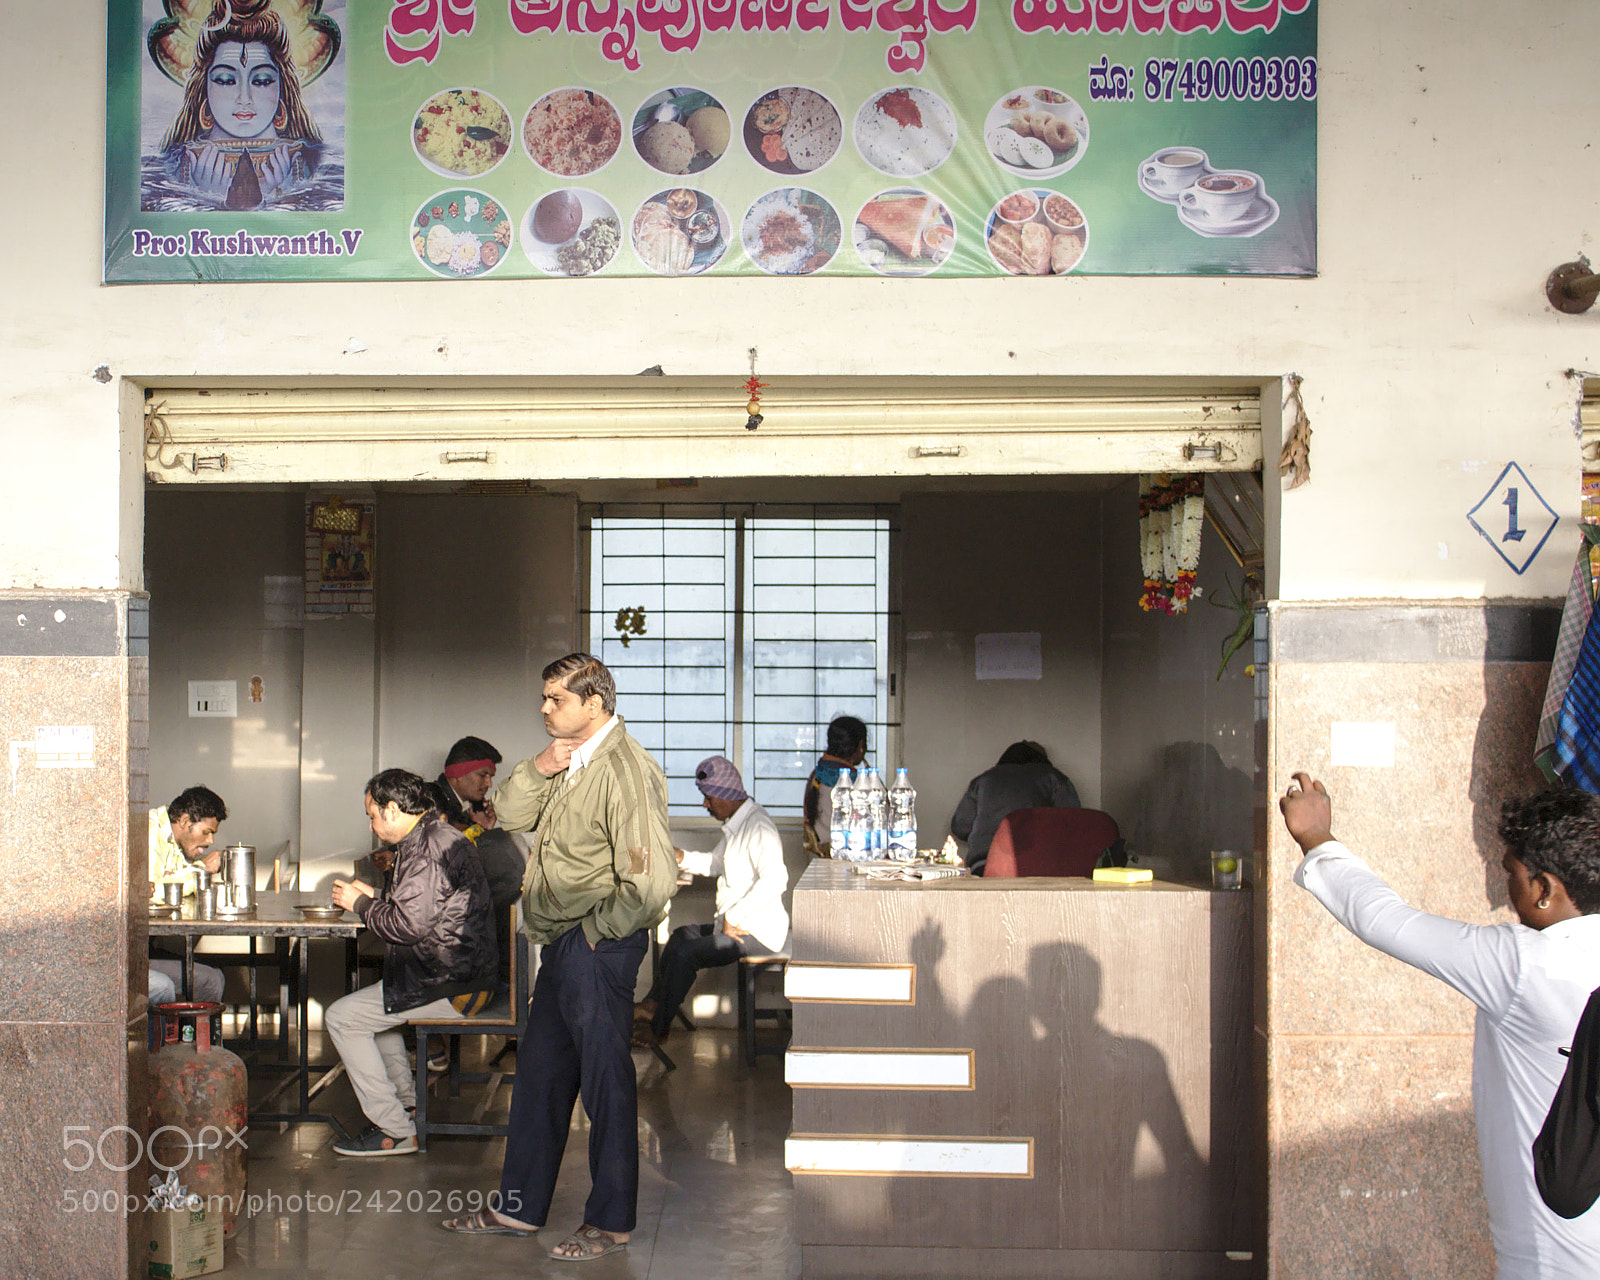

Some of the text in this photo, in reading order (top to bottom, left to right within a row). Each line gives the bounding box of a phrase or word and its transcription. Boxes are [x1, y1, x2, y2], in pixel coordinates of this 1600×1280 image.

[1144, 56, 1317, 102] 8749009393
[132, 229, 363, 256] Pro: Kushwanth.V
[1502, 487, 1527, 543] 1
